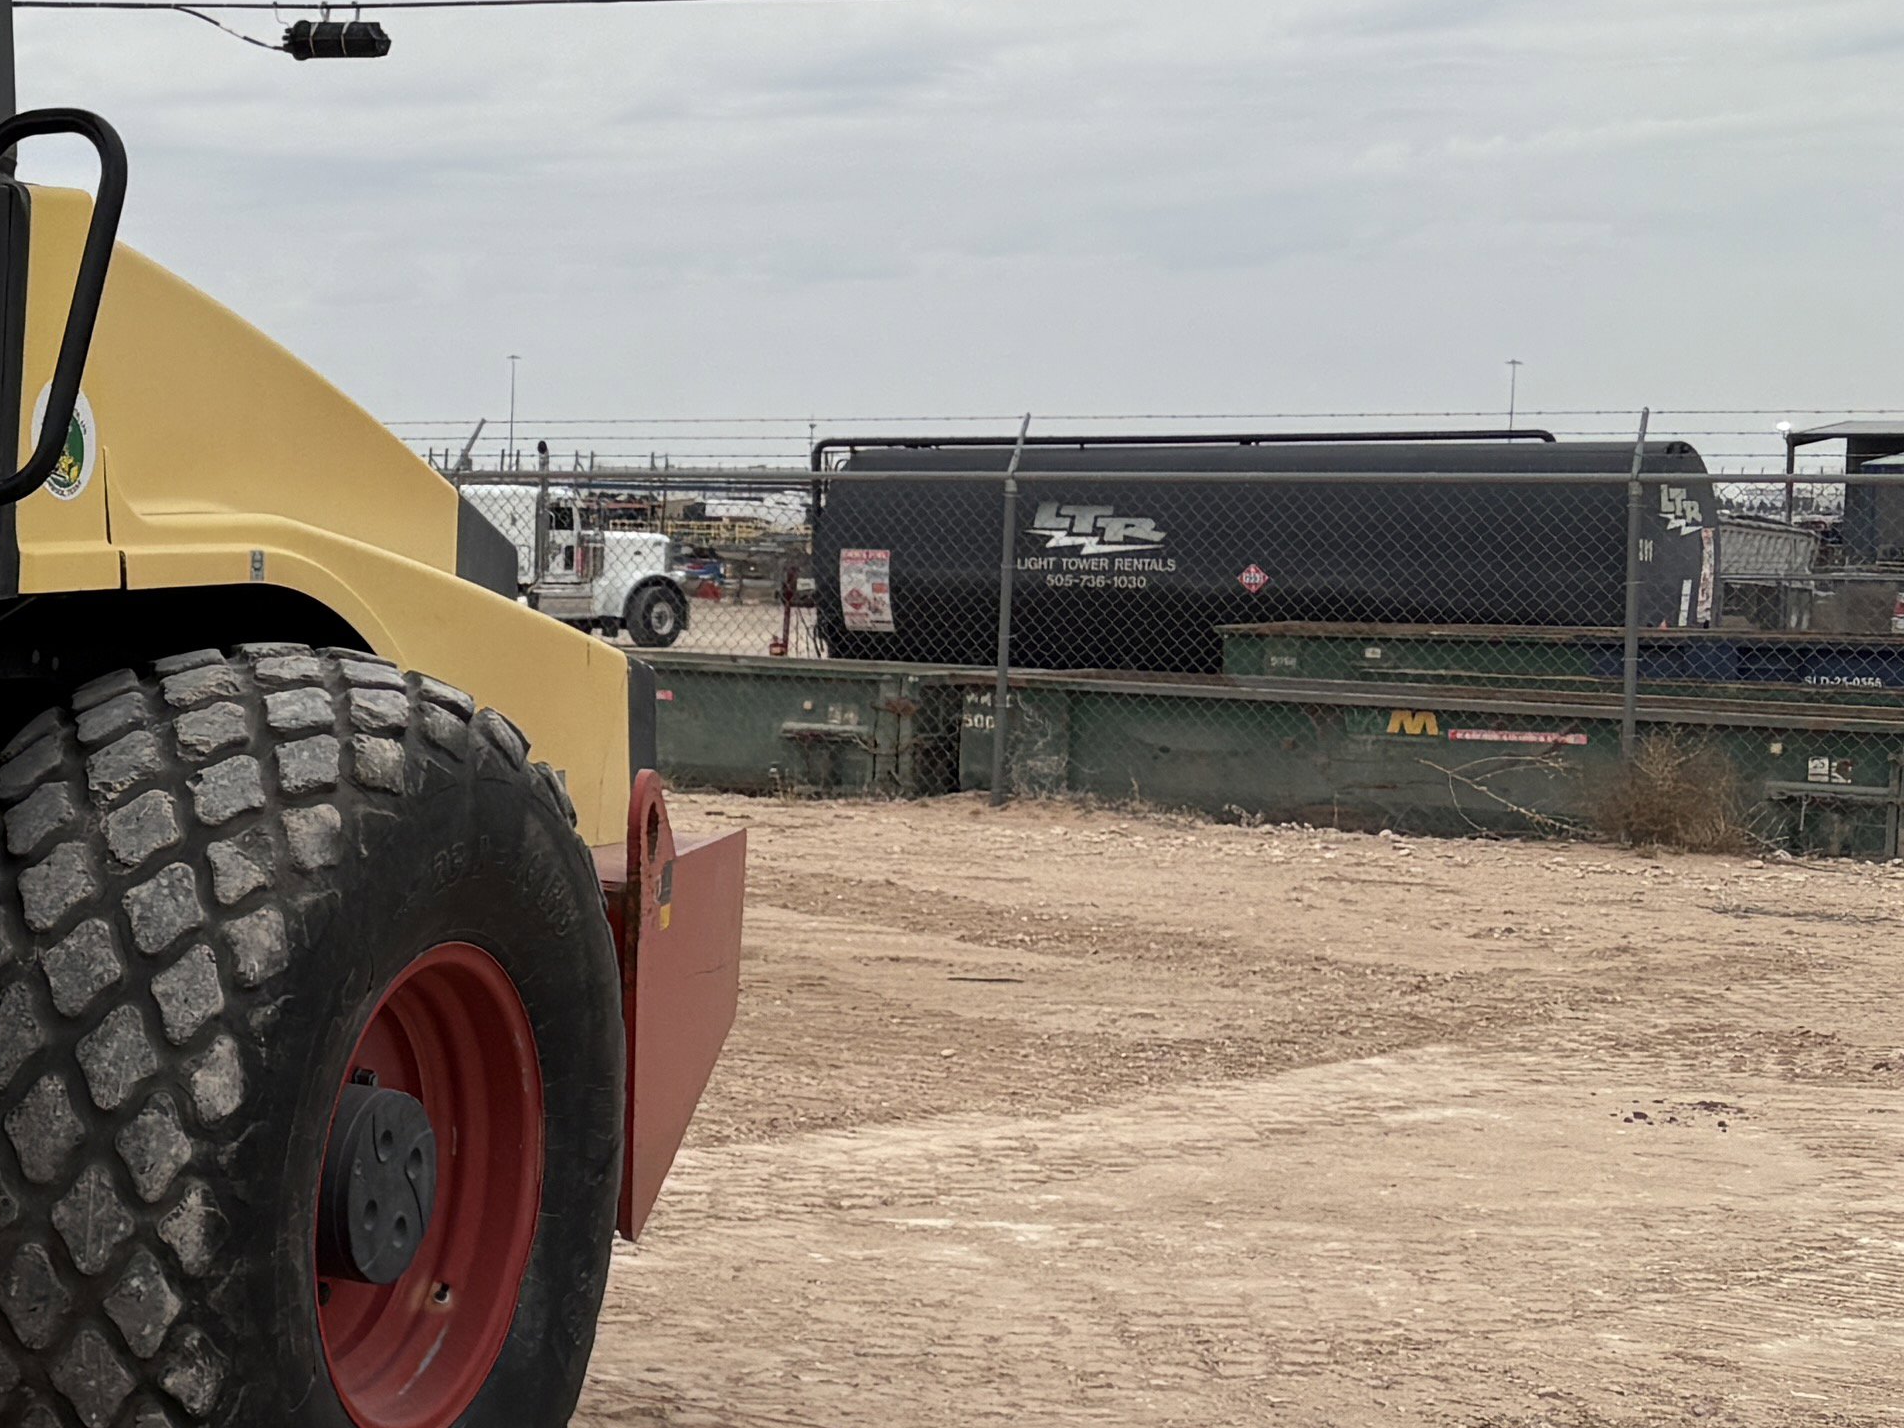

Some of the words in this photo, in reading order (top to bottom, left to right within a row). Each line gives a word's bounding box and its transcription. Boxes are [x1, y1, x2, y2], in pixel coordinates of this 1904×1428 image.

[1033, 501, 1168, 542] LTR
[1660, 483, 1702, 523] LTR
[1017, 556, 1057, 570] LIGHT
[1061, 557, 1109, 571] TOWER
[1114, 557, 1176, 572] RENTALS
